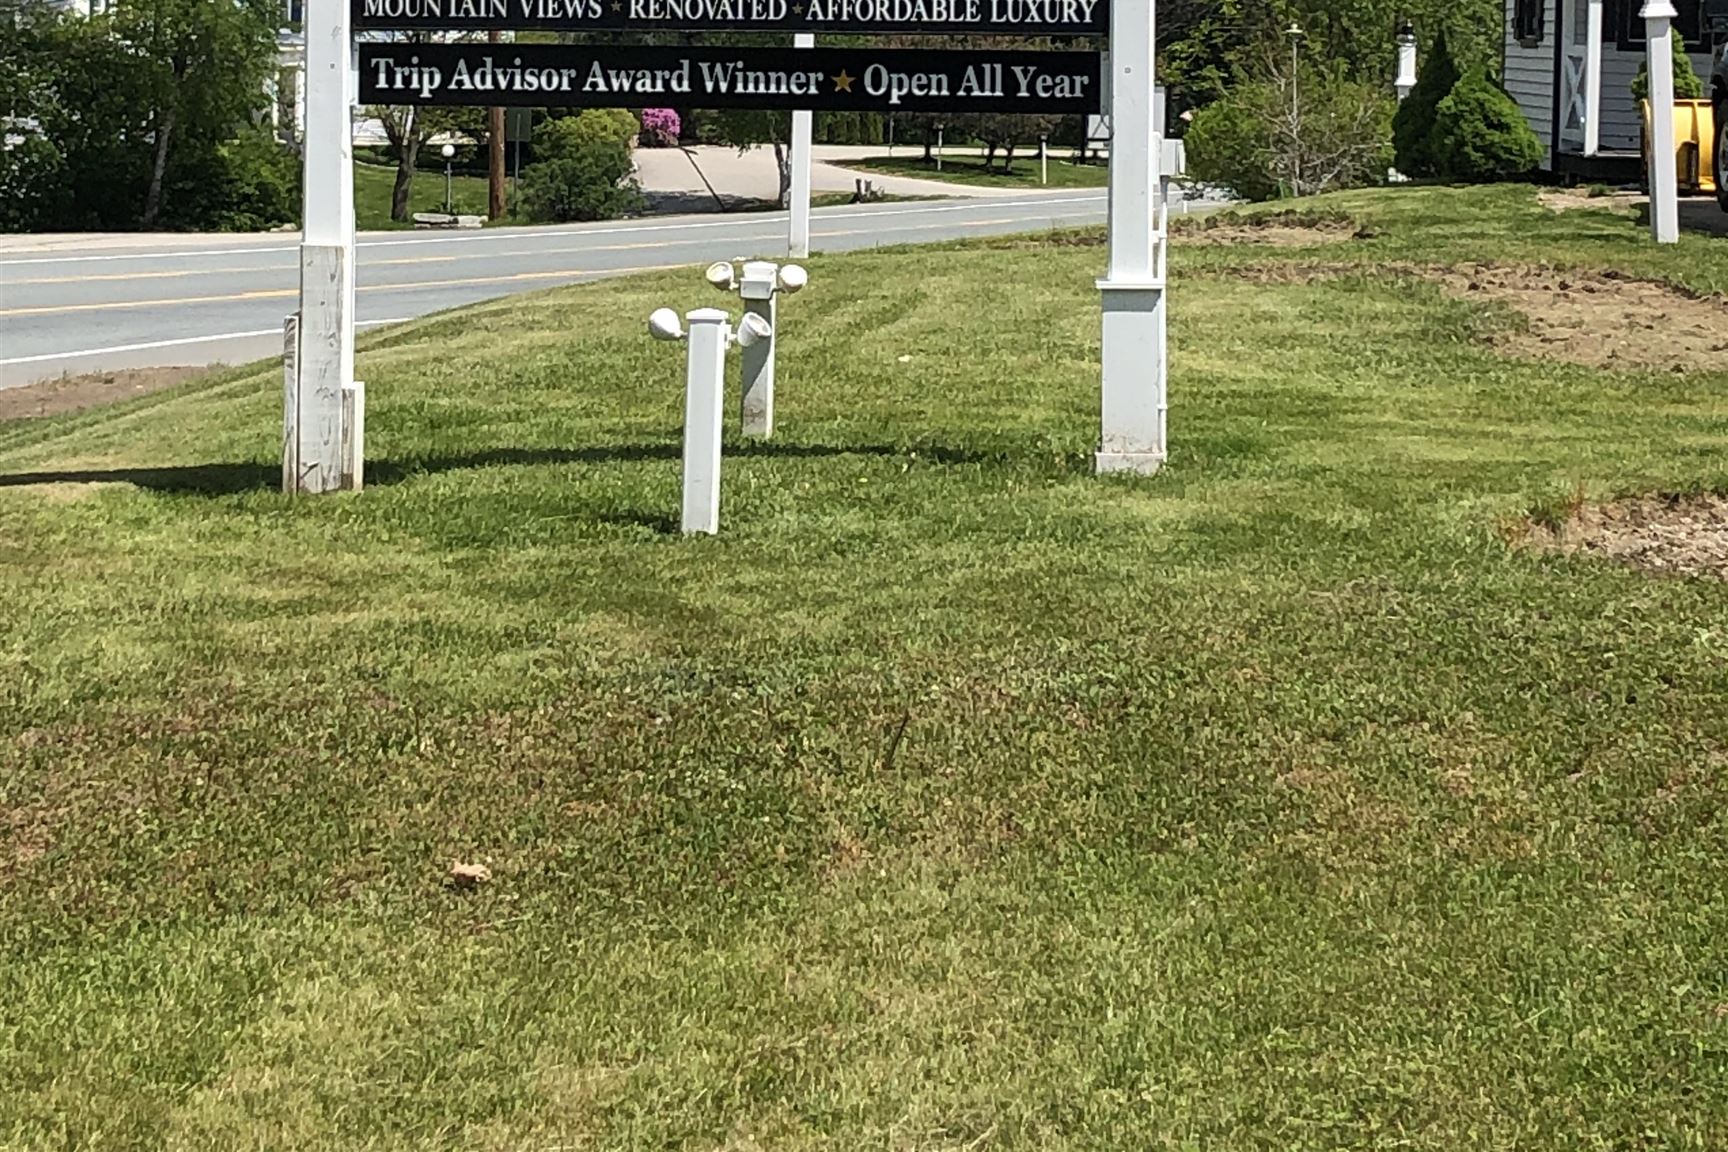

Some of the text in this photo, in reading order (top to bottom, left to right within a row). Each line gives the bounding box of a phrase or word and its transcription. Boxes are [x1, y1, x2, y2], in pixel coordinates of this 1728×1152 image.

[371, 57, 1089, 104] Trip Advisor Award Winner Open All Year
